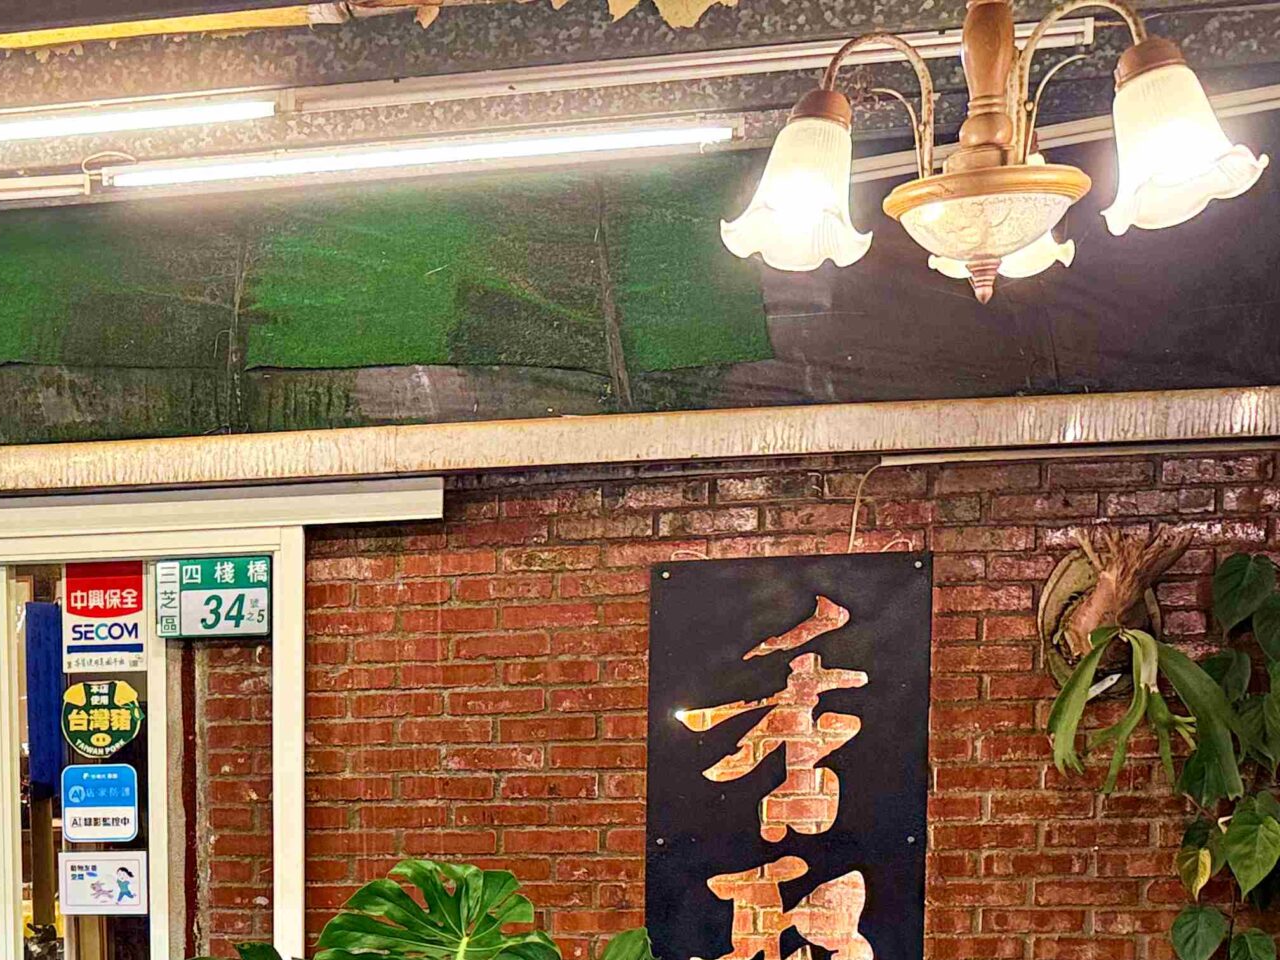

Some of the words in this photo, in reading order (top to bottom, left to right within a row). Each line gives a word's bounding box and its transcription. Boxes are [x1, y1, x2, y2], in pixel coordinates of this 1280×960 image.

[182, 560, 268, 585] 四棧橋
[70, 588, 138, 611] 中興保全
[160, 566, 178, 634] 三芝區
[200, 593, 247, 630] 34
[71, 622, 139, 641] SECOM
[68, 708, 132, 732] 台灣豬
[75, 738, 104, 755] TAIWAN
[104, 738, 126, 755] PORK
